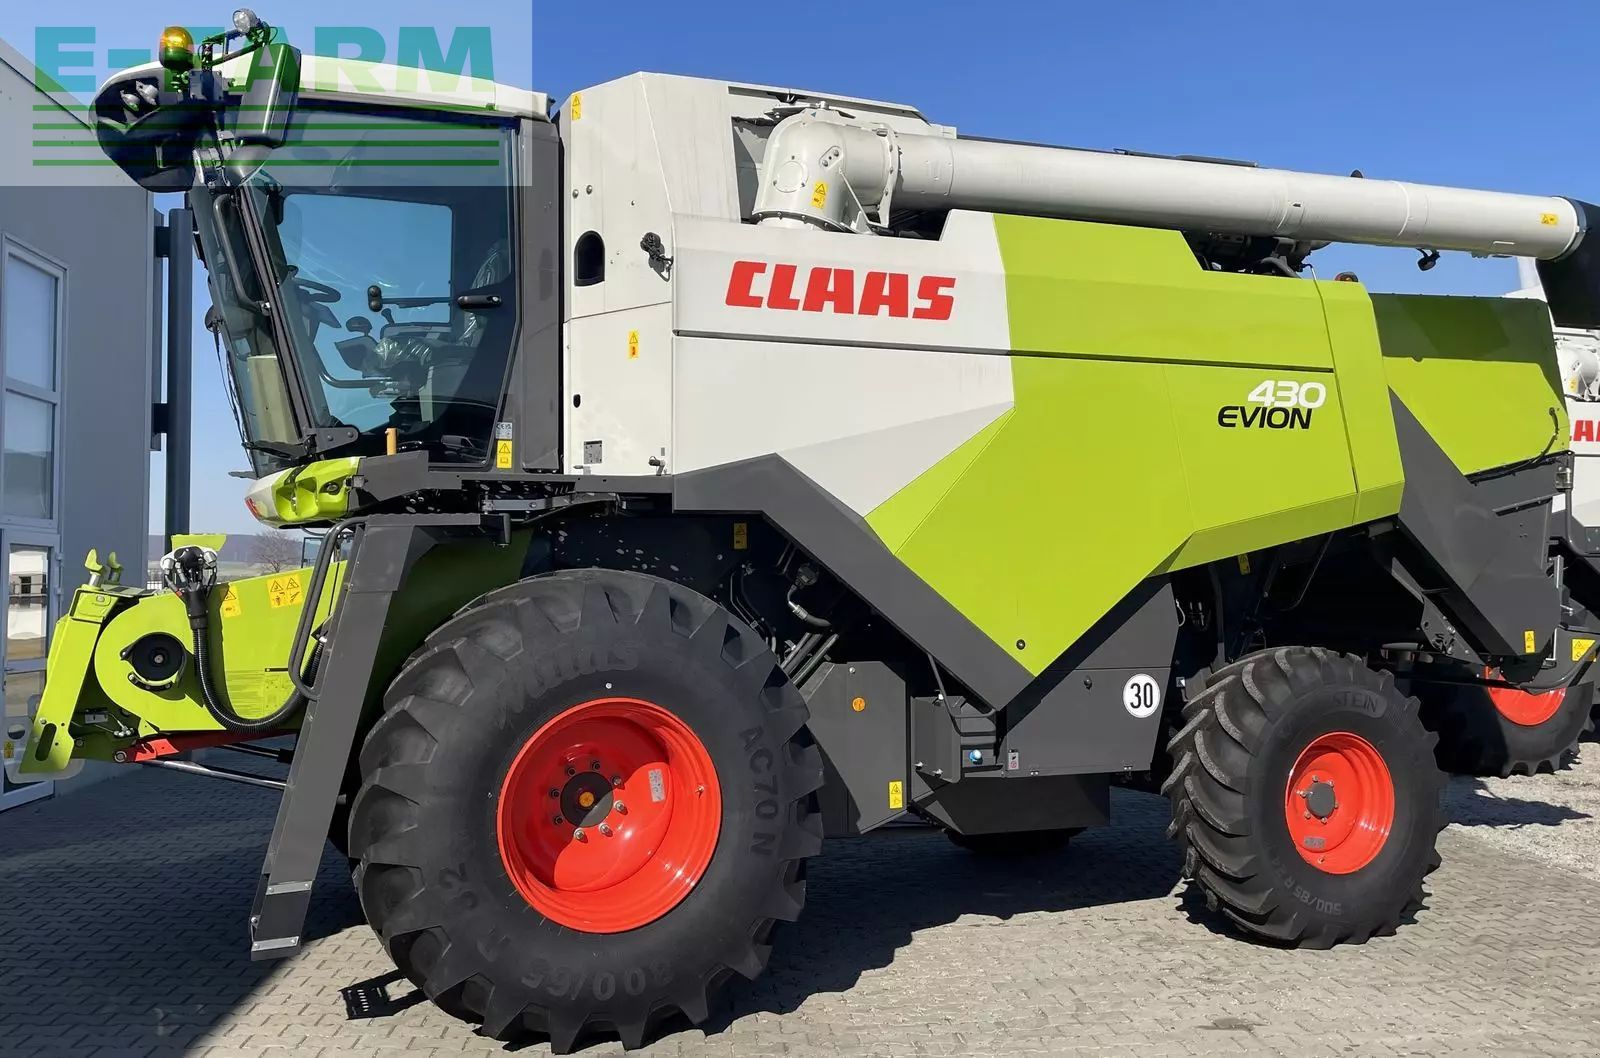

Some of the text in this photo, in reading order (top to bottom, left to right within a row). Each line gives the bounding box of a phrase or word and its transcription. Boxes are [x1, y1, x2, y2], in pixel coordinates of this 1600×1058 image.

[725, 260, 956, 321] CLAAS
[1247, 379, 1327, 409] 430
[1217, 405, 1313, 430] EVION
[1130, 682, 1154, 709] 30
[1293, 885, 1343, 916] 500/85
